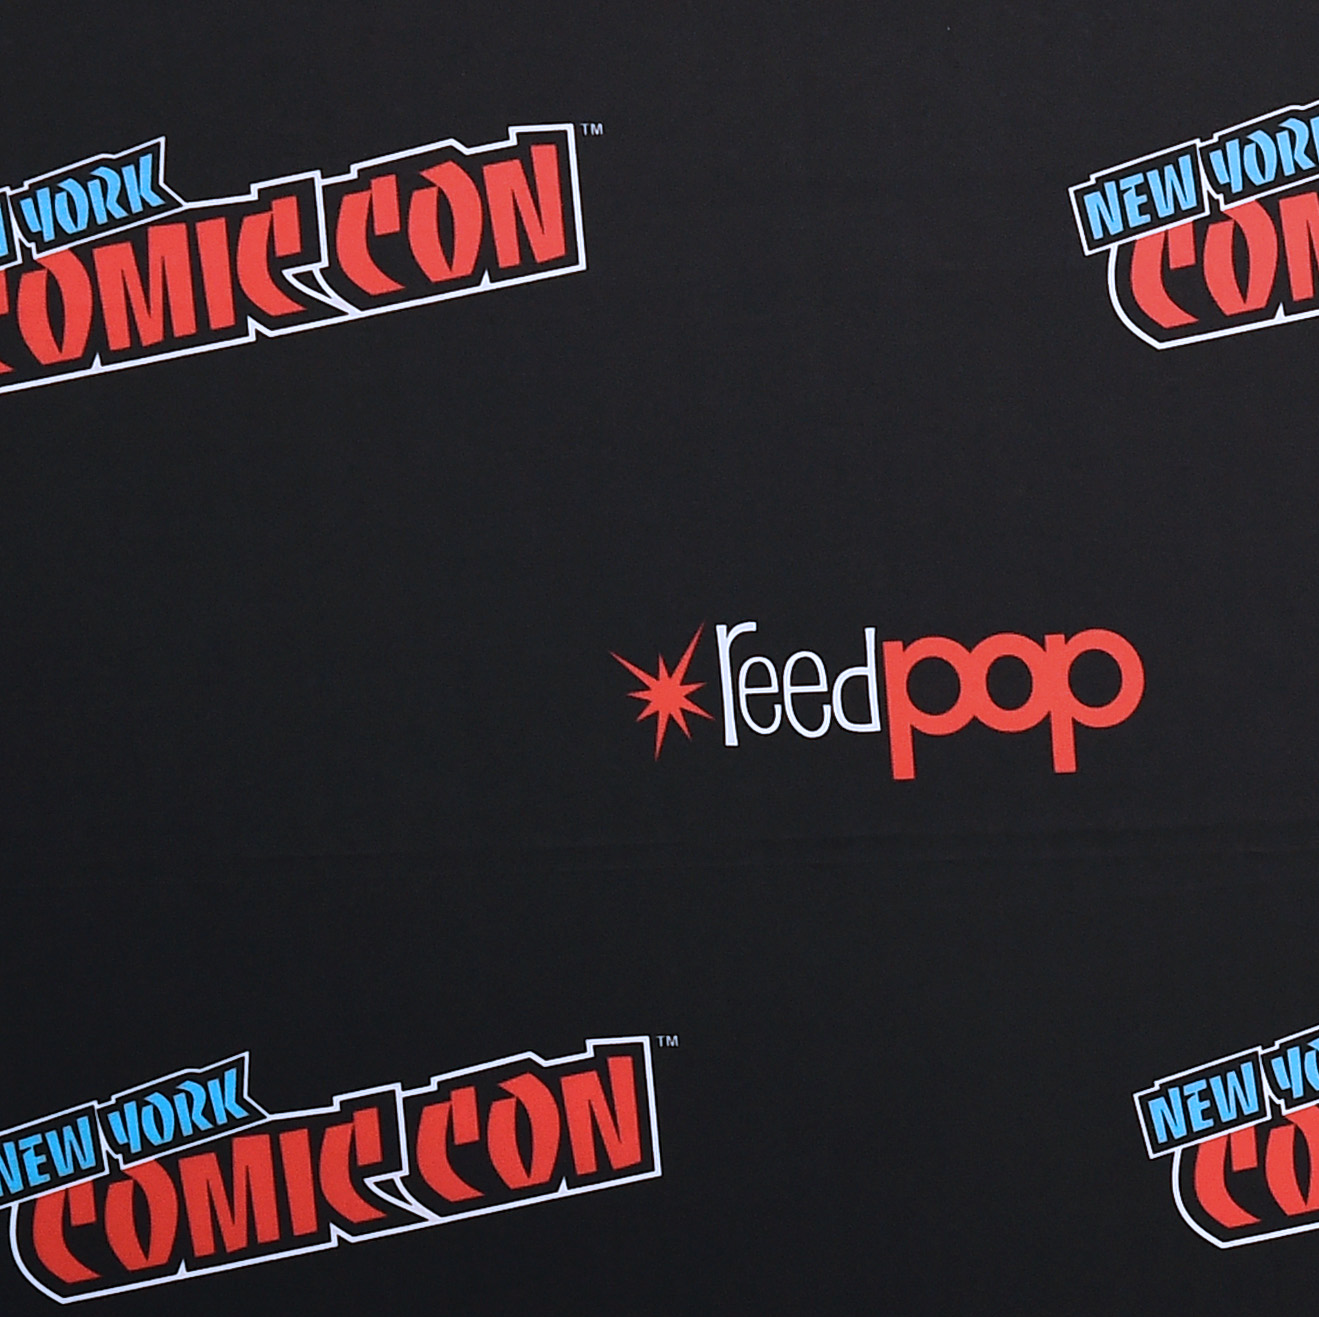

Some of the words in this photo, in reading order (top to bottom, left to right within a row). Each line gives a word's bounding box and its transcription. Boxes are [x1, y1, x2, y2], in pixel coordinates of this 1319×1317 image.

[20, 153, 163, 243] YORK
[1084, 156, 1197, 239] NEW
[0, 195, 306, 374] OMIC
[336, 143, 566, 296] CON
[107, 1067, 249, 1154] YORK
[1148, 1061, 1260, 1144] NEW
[32, 1107, 387, 1284] COMIC
[416, 1055, 642, 1202] CON
